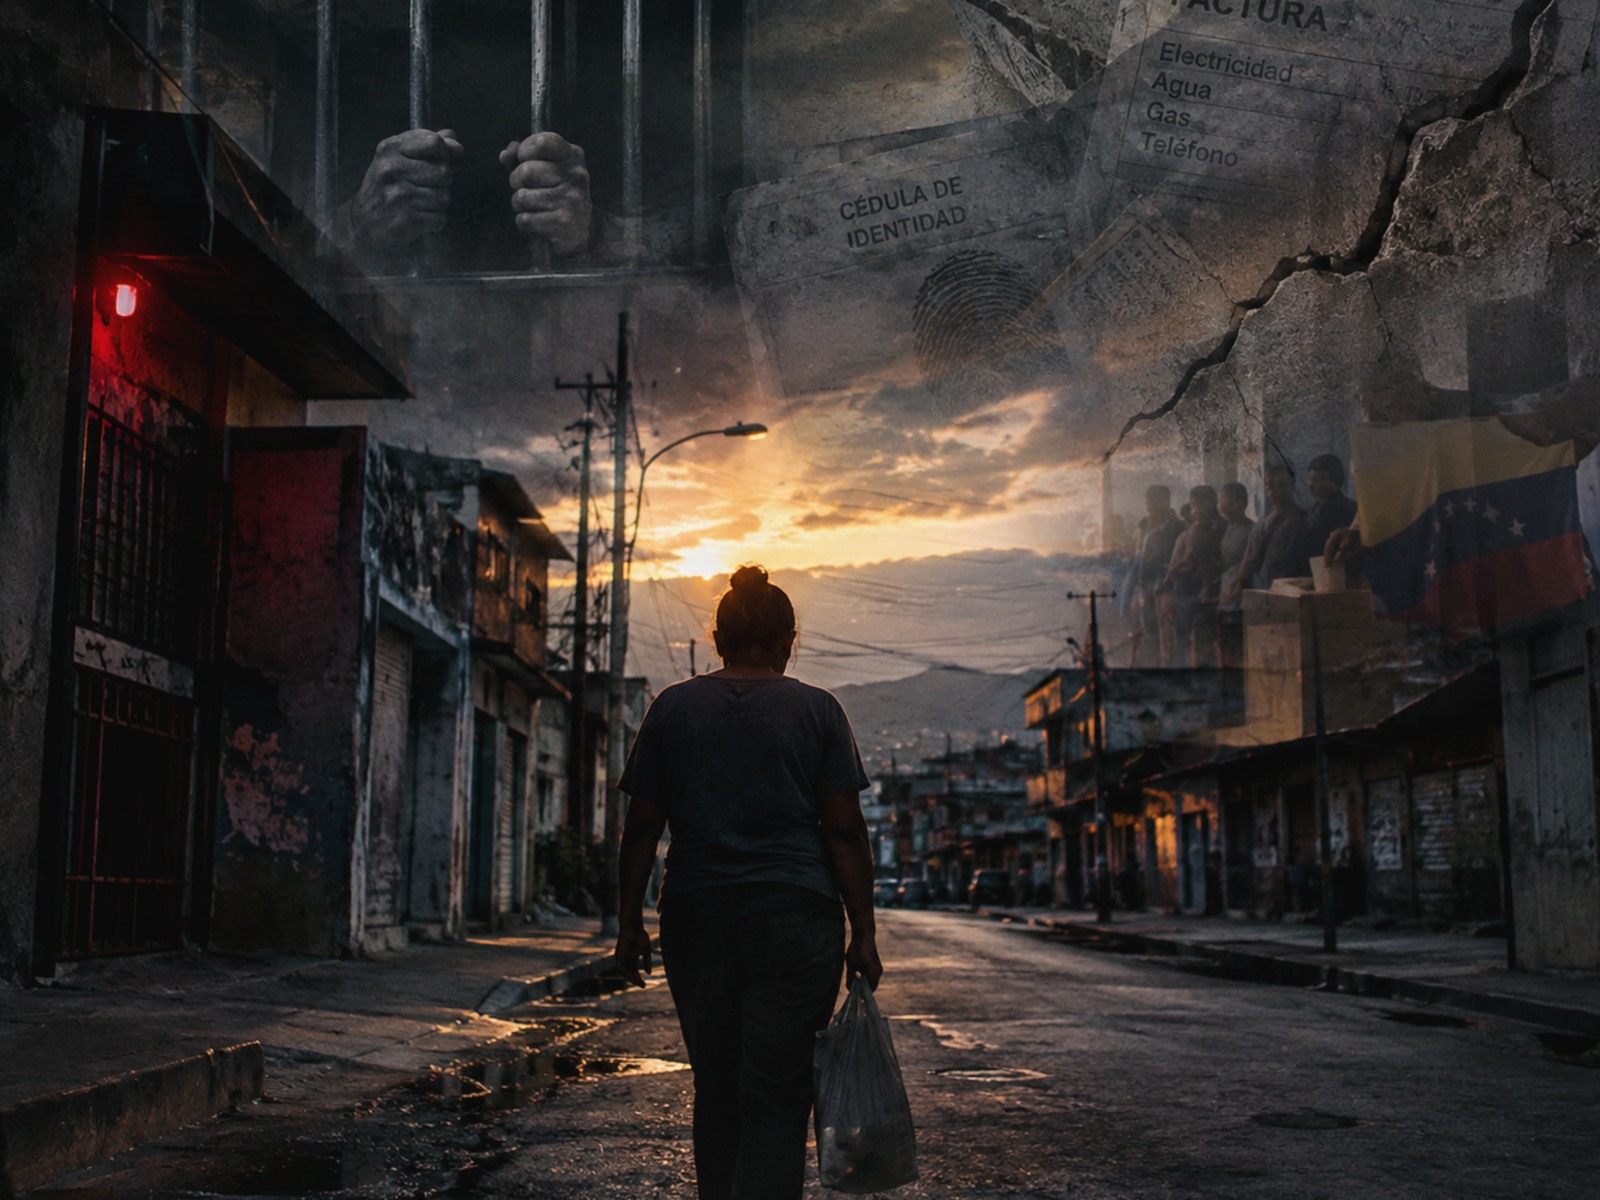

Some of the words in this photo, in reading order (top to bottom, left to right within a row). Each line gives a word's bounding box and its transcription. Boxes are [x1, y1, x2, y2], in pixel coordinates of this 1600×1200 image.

[1171, 0, 1327, 32] ACTURA
[1160, 42, 1294, 83] Electricidad
[1152, 73, 1212, 100] Agua
[1147, 102, 1191, 127] Gas
[1141, 132, 1238, 167] Teléfono
[840, 185, 928, 220] CÉDULA
[934, 176, 963, 198] DE
[847, 206, 967, 248] IDENTIDAD
